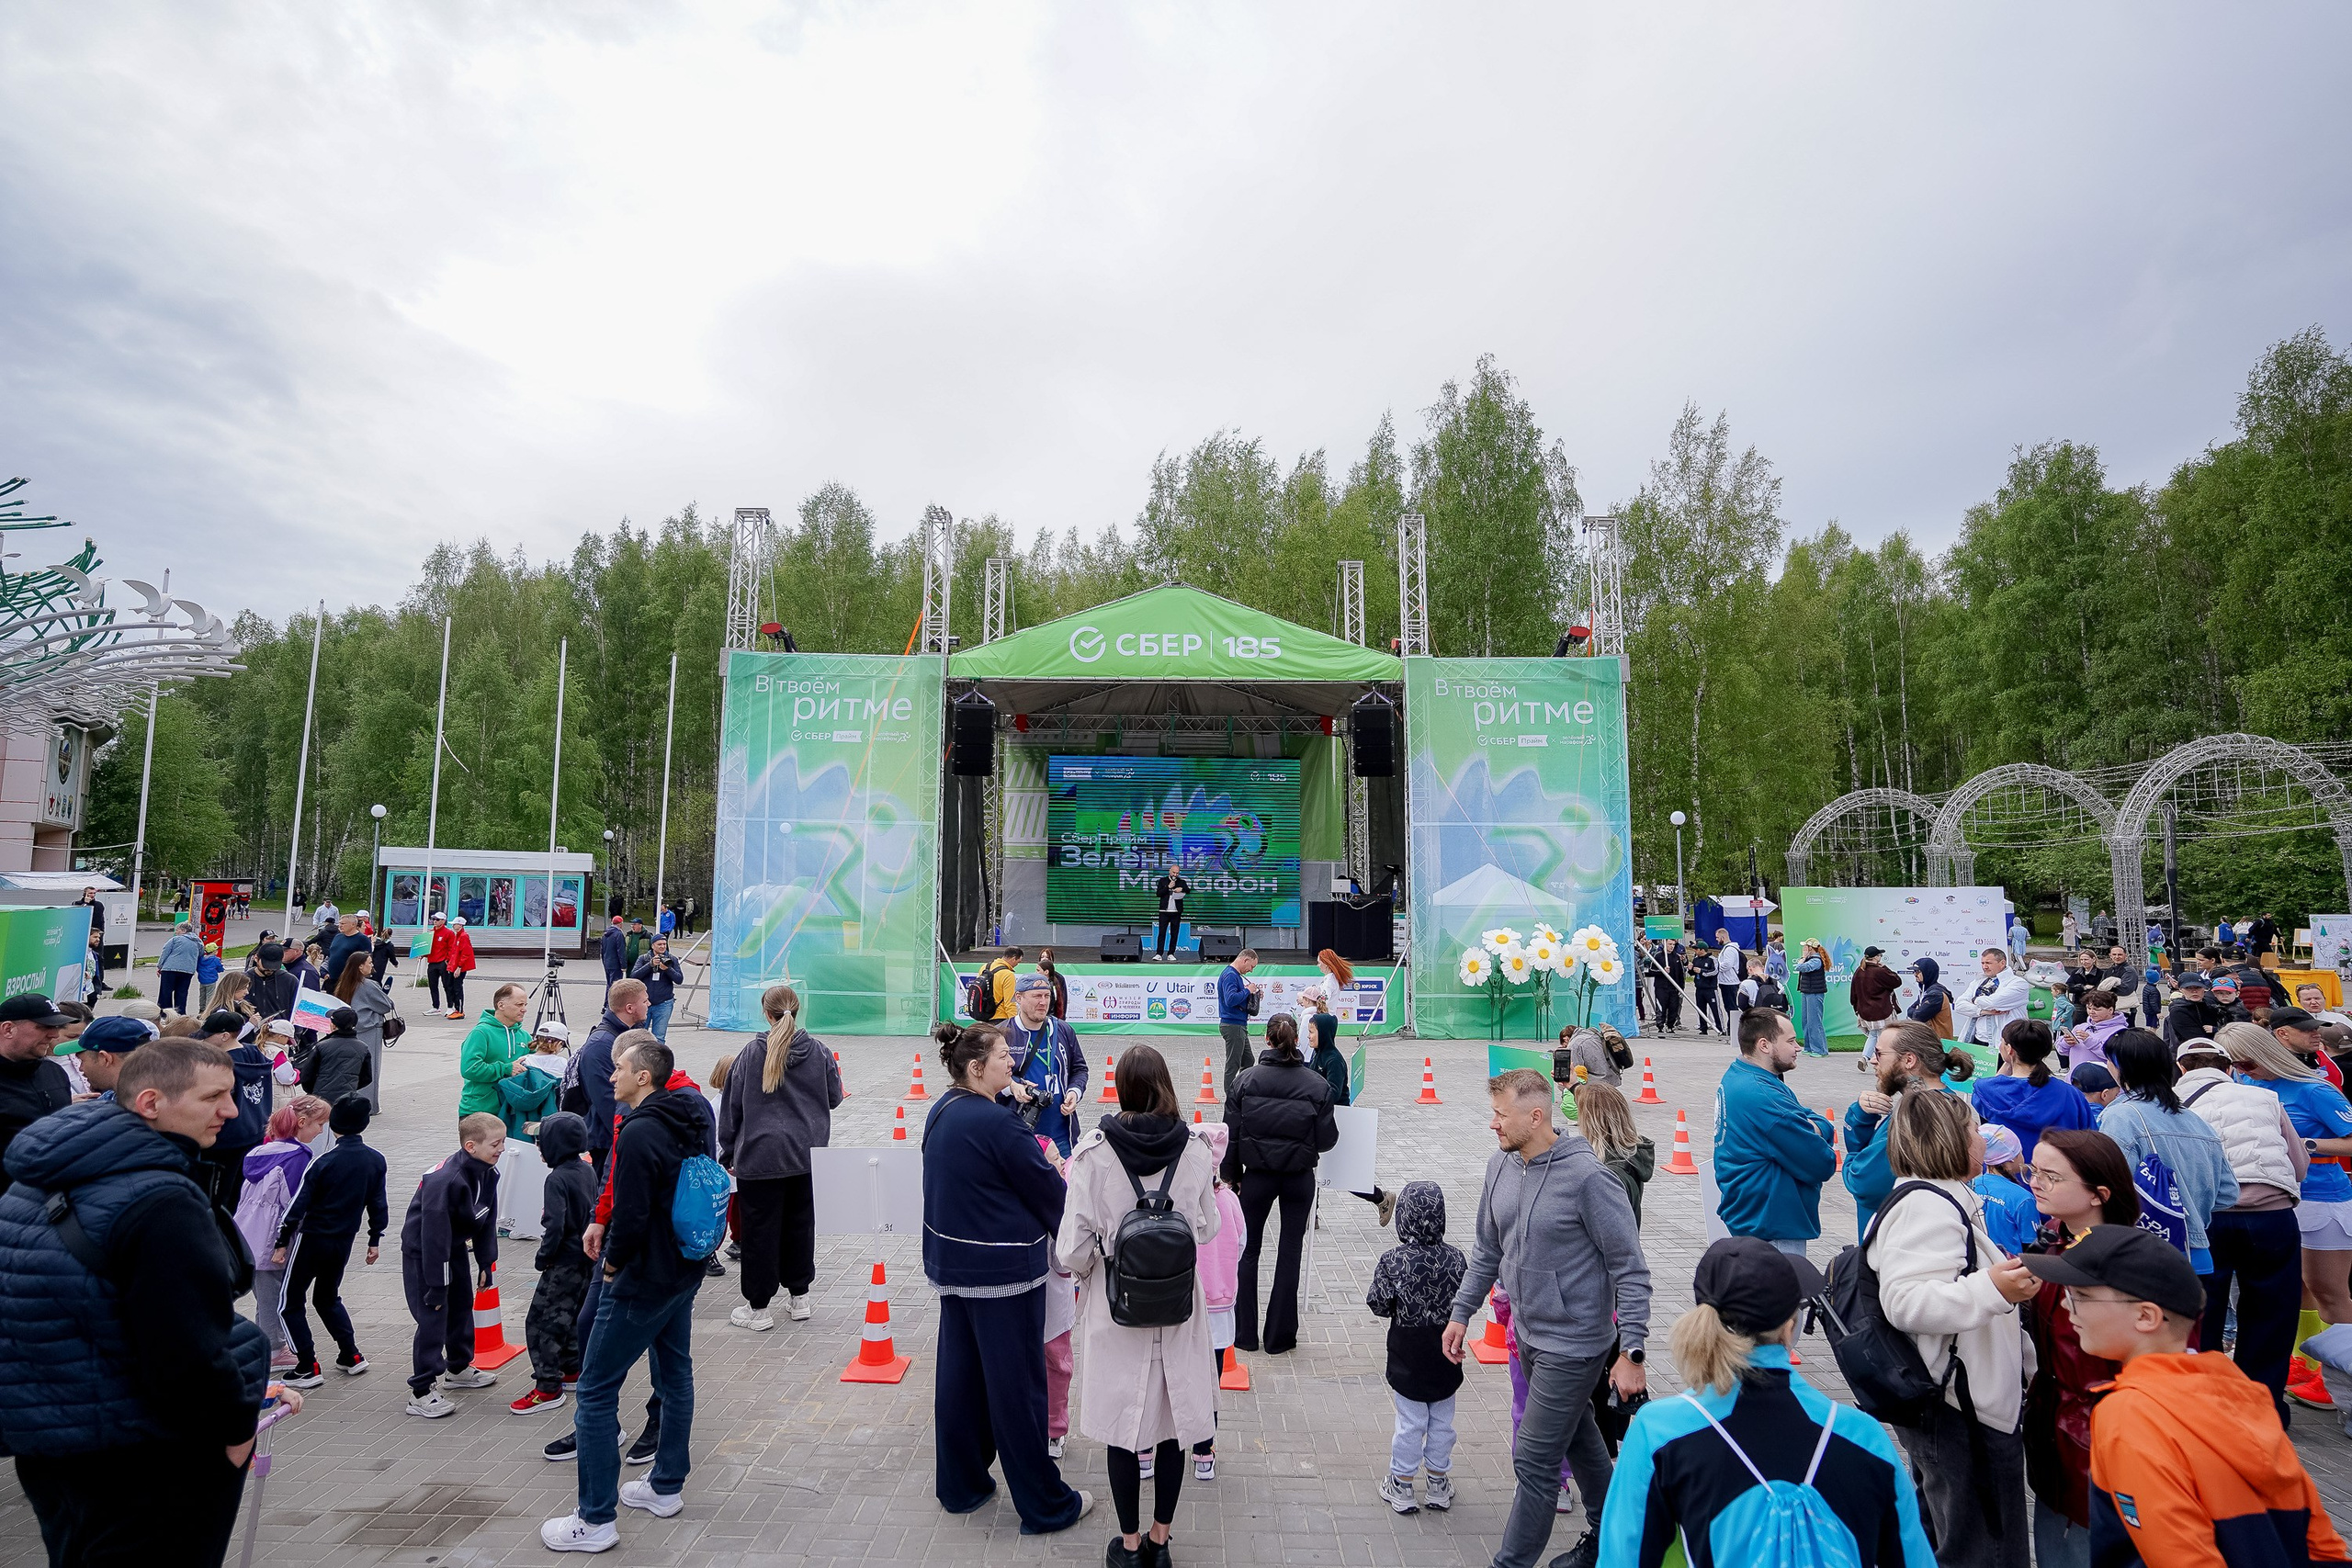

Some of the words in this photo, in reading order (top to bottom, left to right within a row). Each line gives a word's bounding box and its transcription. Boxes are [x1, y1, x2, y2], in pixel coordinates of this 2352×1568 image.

[1115, 633, 1203, 657] СБЕР
[1222, 637, 1282, 660] 185
[755, 674, 769, 693] В
[776, 677, 841, 694] твоём
[1435, 678, 1449, 696] В
[1453, 682, 1517, 699] твоём
[792, 695, 913, 728] ритме
[1473, 700, 1594, 732] ритме
[804, 731, 831, 740] СБЕР
[835, 732, 857, 741] Прайм
[1489, 737, 1516, 745] СБЕР
[1521, 737, 1544, 745] Прайм
[1060, 831, 1148, 845] СберПрайм
[1060, 845, 1205, 869] Зелёный
[5, 966, 47, 998] ВЗРОСЛЫЙ
[1166, 982, 1195, 994] Utair
[504, 1217, 516, 1227] 32
[884, 1223, 893, 1232] 31
